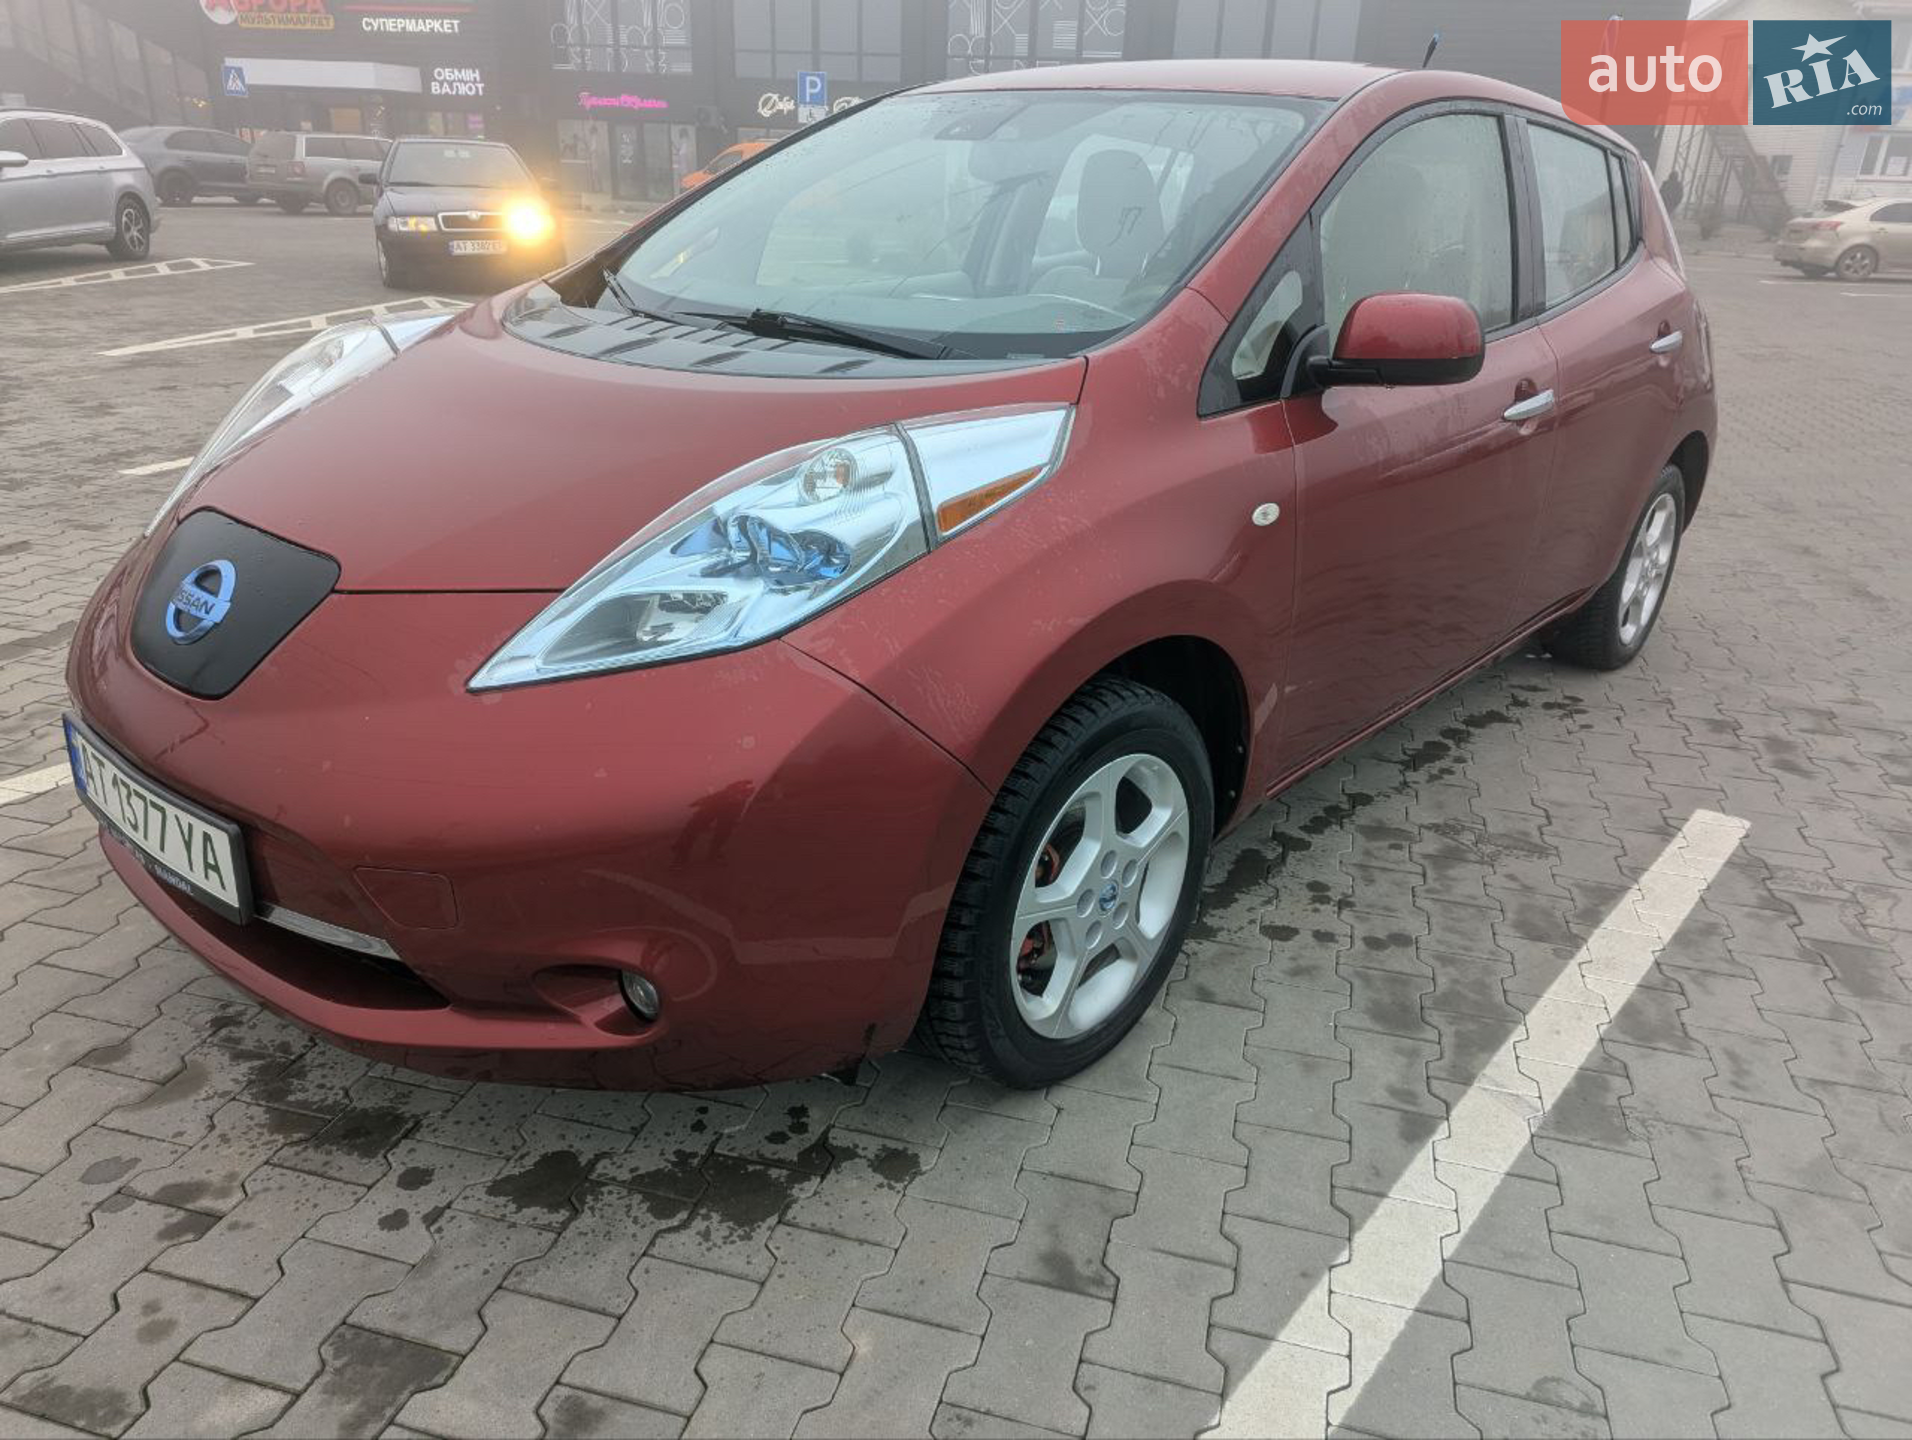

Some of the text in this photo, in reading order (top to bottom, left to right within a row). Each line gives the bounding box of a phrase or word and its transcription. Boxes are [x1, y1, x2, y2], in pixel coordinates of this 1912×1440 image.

[362, 17, 461, 32] СУПЕРМАРКЕТ
[433, 67, 480, 81] ОБМІН
[431, 82, 485, 96] ВАЛЮТ
[806, 75, 821, 103] P
[81, 742, 108, 807] AT
[112, 772, 167, 854] 1377
[175, 813, 227, 892] YA
